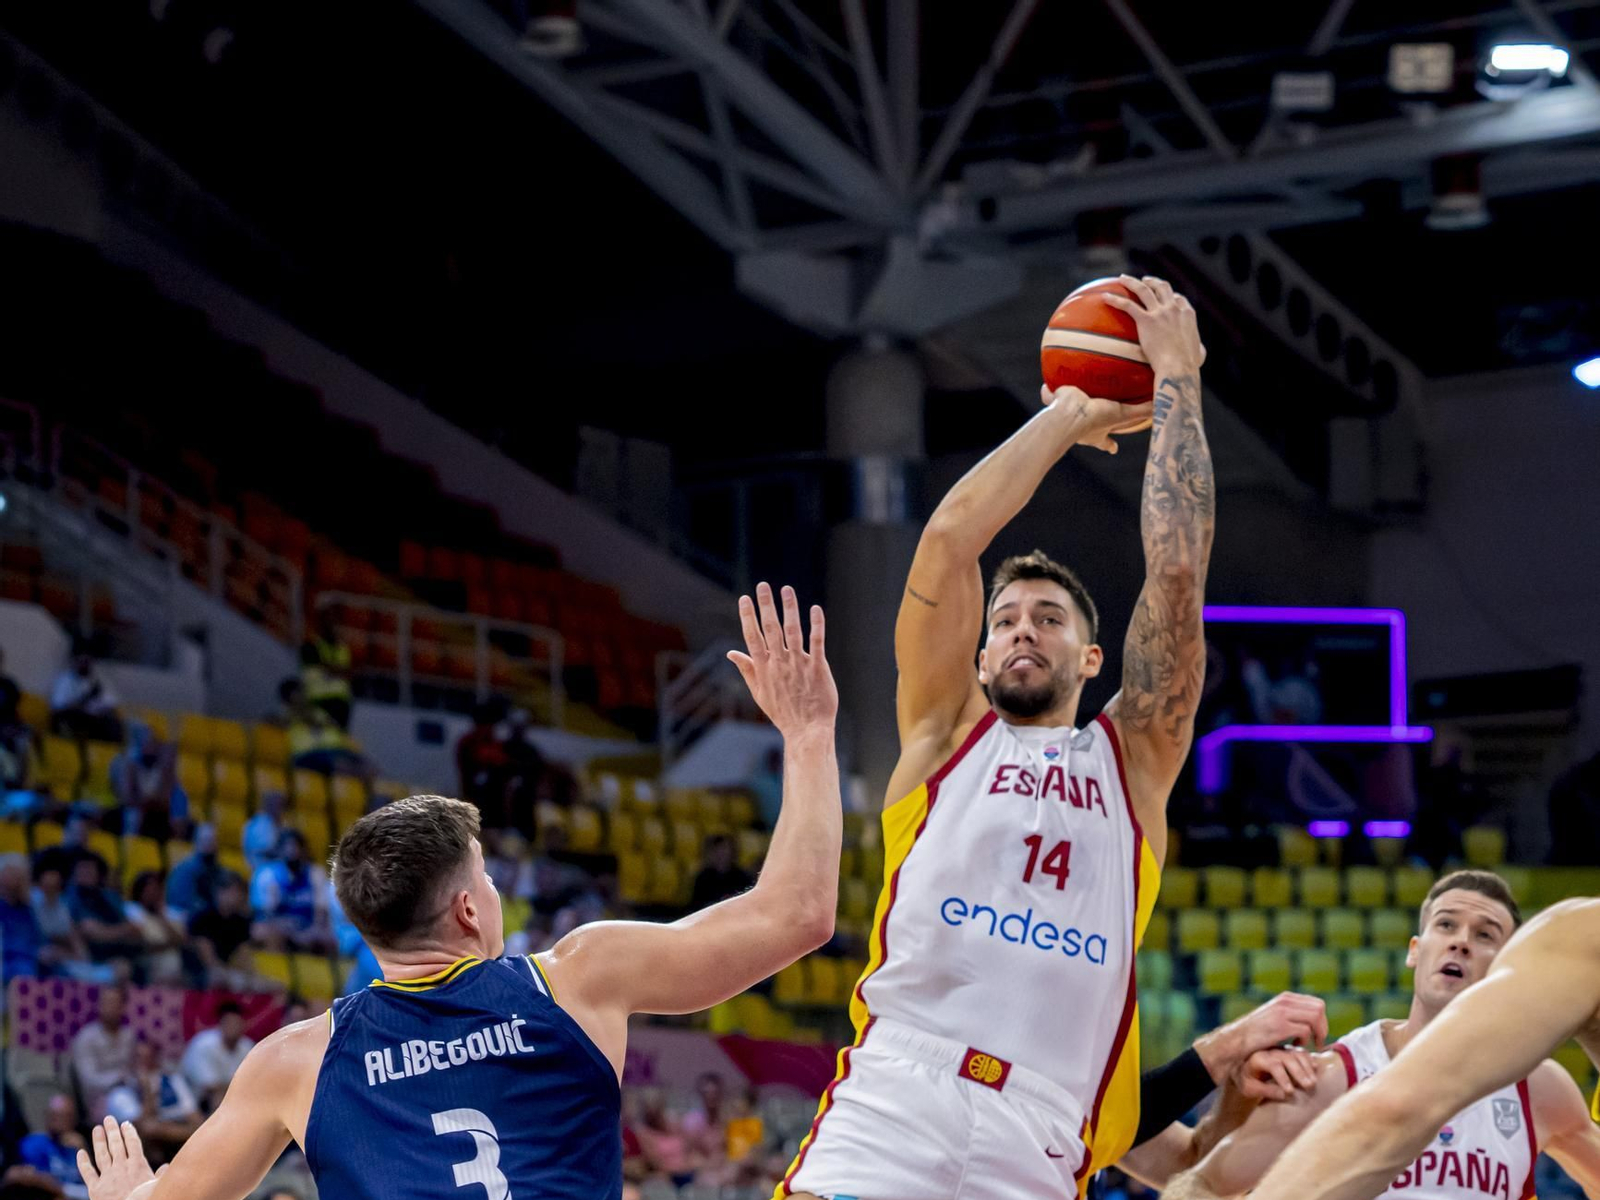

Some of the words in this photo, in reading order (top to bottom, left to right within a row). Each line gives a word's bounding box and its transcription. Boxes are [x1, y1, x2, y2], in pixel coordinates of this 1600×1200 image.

[988, 764, 1108, 818] ESAA
[1022, 834, 1071, 890] 14
[940, 896, 1107, 966] endesa
